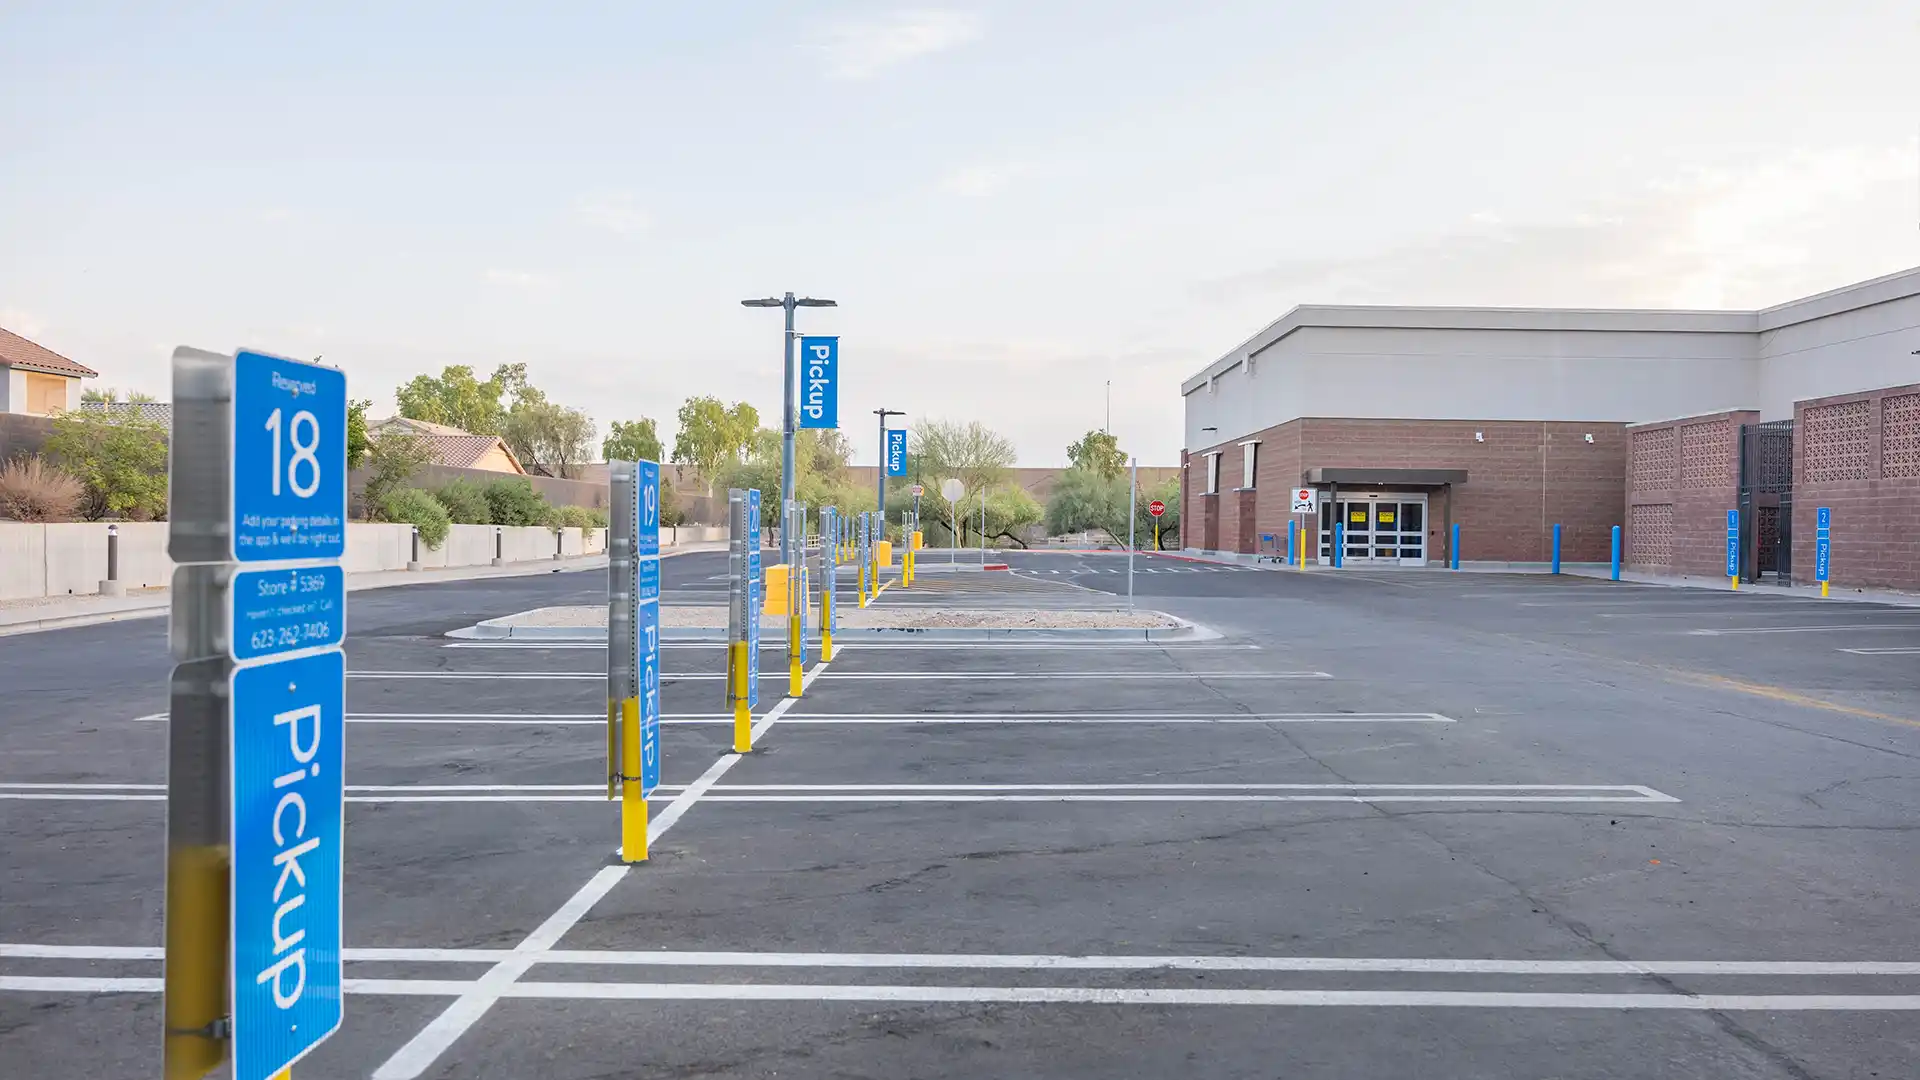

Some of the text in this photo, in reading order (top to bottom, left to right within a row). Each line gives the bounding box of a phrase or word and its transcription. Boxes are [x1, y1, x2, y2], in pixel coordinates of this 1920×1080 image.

[803, 345, 830, 419] Pickup
[265, 407, 321, 499] 18
[889, 434, 903, 471] Pickup
[242, 514, 260, 527] Add
[261, 516, 278, 531] your
[643, 484, 655, 527] 19
[1821, 512, 1827, 523] 2
[1729, 542, 1737, 571] Pickup
[1818, 544, 1828, 576] Pickup
[258, 579, 288, 597] Store
[645, 624, 656, 767] Pickup
[257, 704, 321, 1010] Pickup
